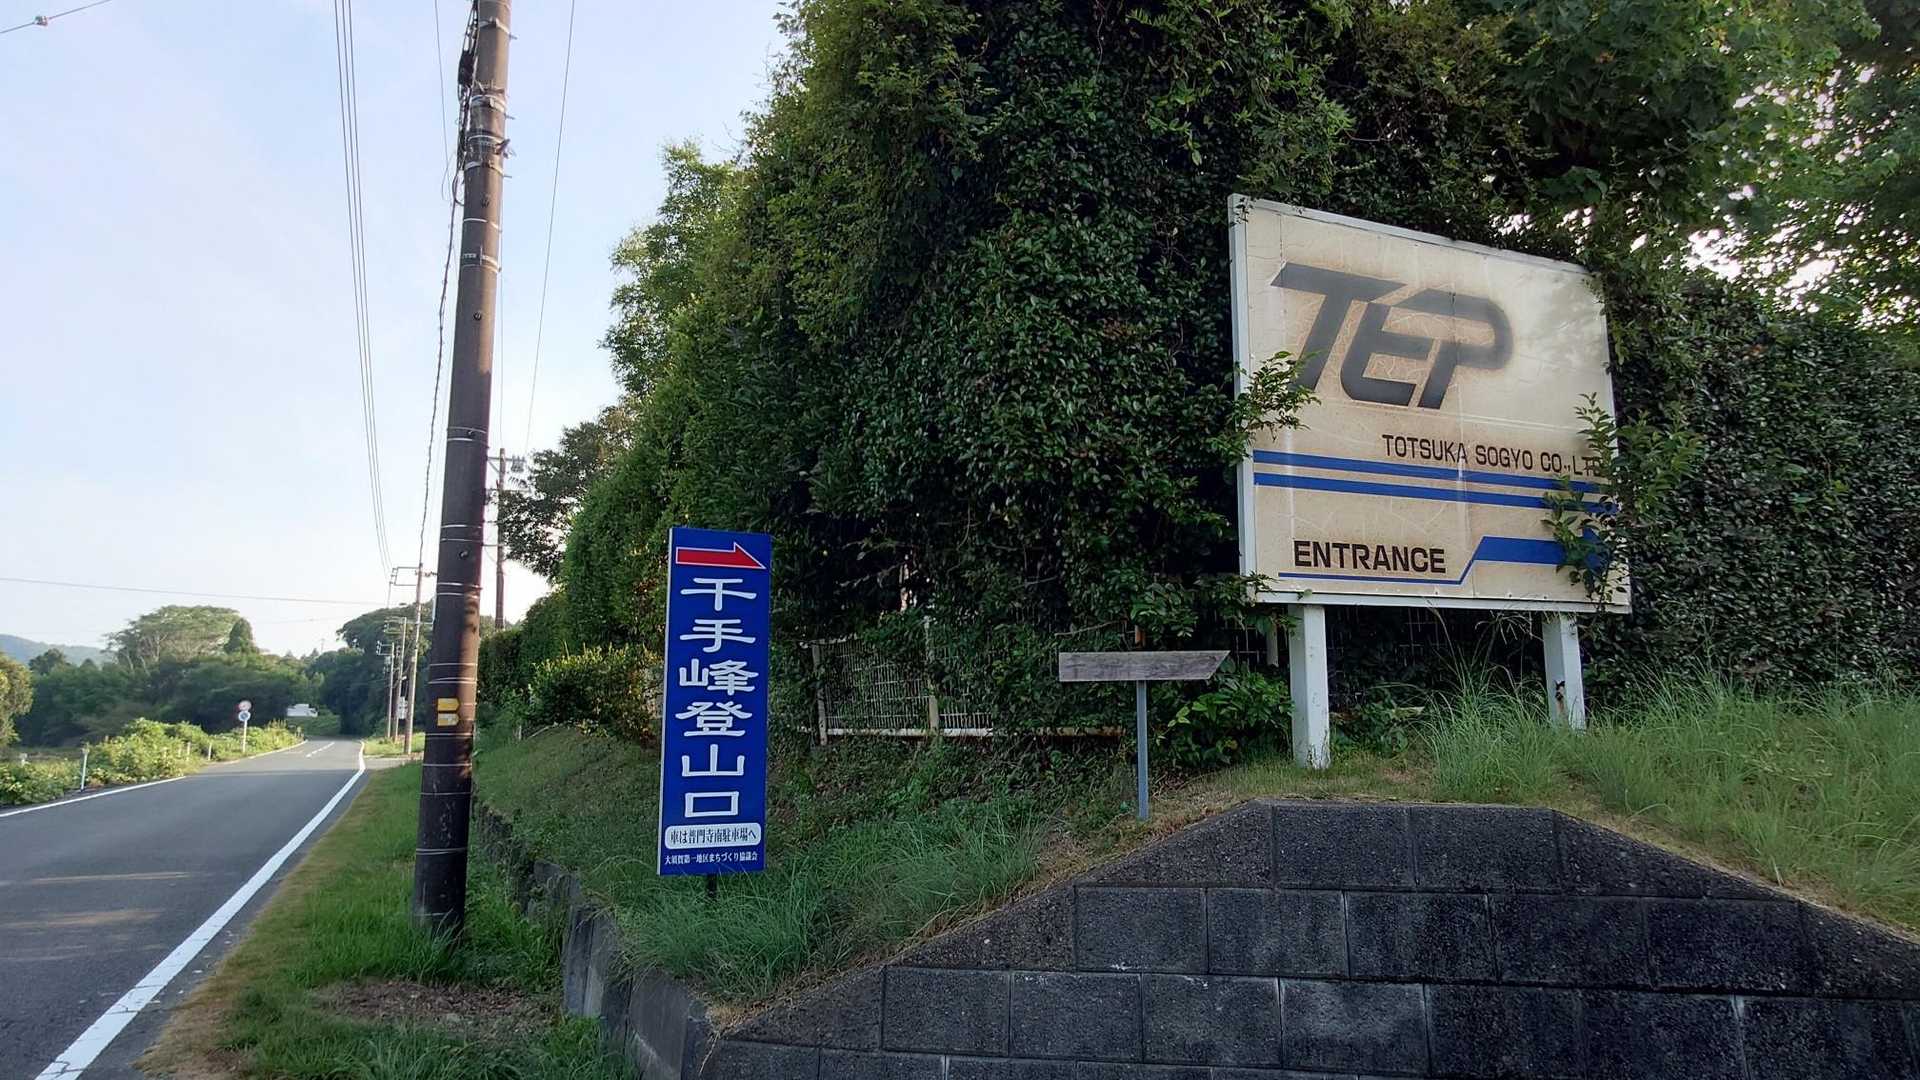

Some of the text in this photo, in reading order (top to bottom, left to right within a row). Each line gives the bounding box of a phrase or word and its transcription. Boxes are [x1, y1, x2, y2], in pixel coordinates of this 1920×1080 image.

[1270, 262, 1513, 410] TEP
[1382, 434, 1468, 464] TOTSUKA
[1475, 444, 1533, 470] SOGYO
[1294, 540, 1446, 573] ENTRANCE
[675, 577, 759, 818] 千手峰登山口
